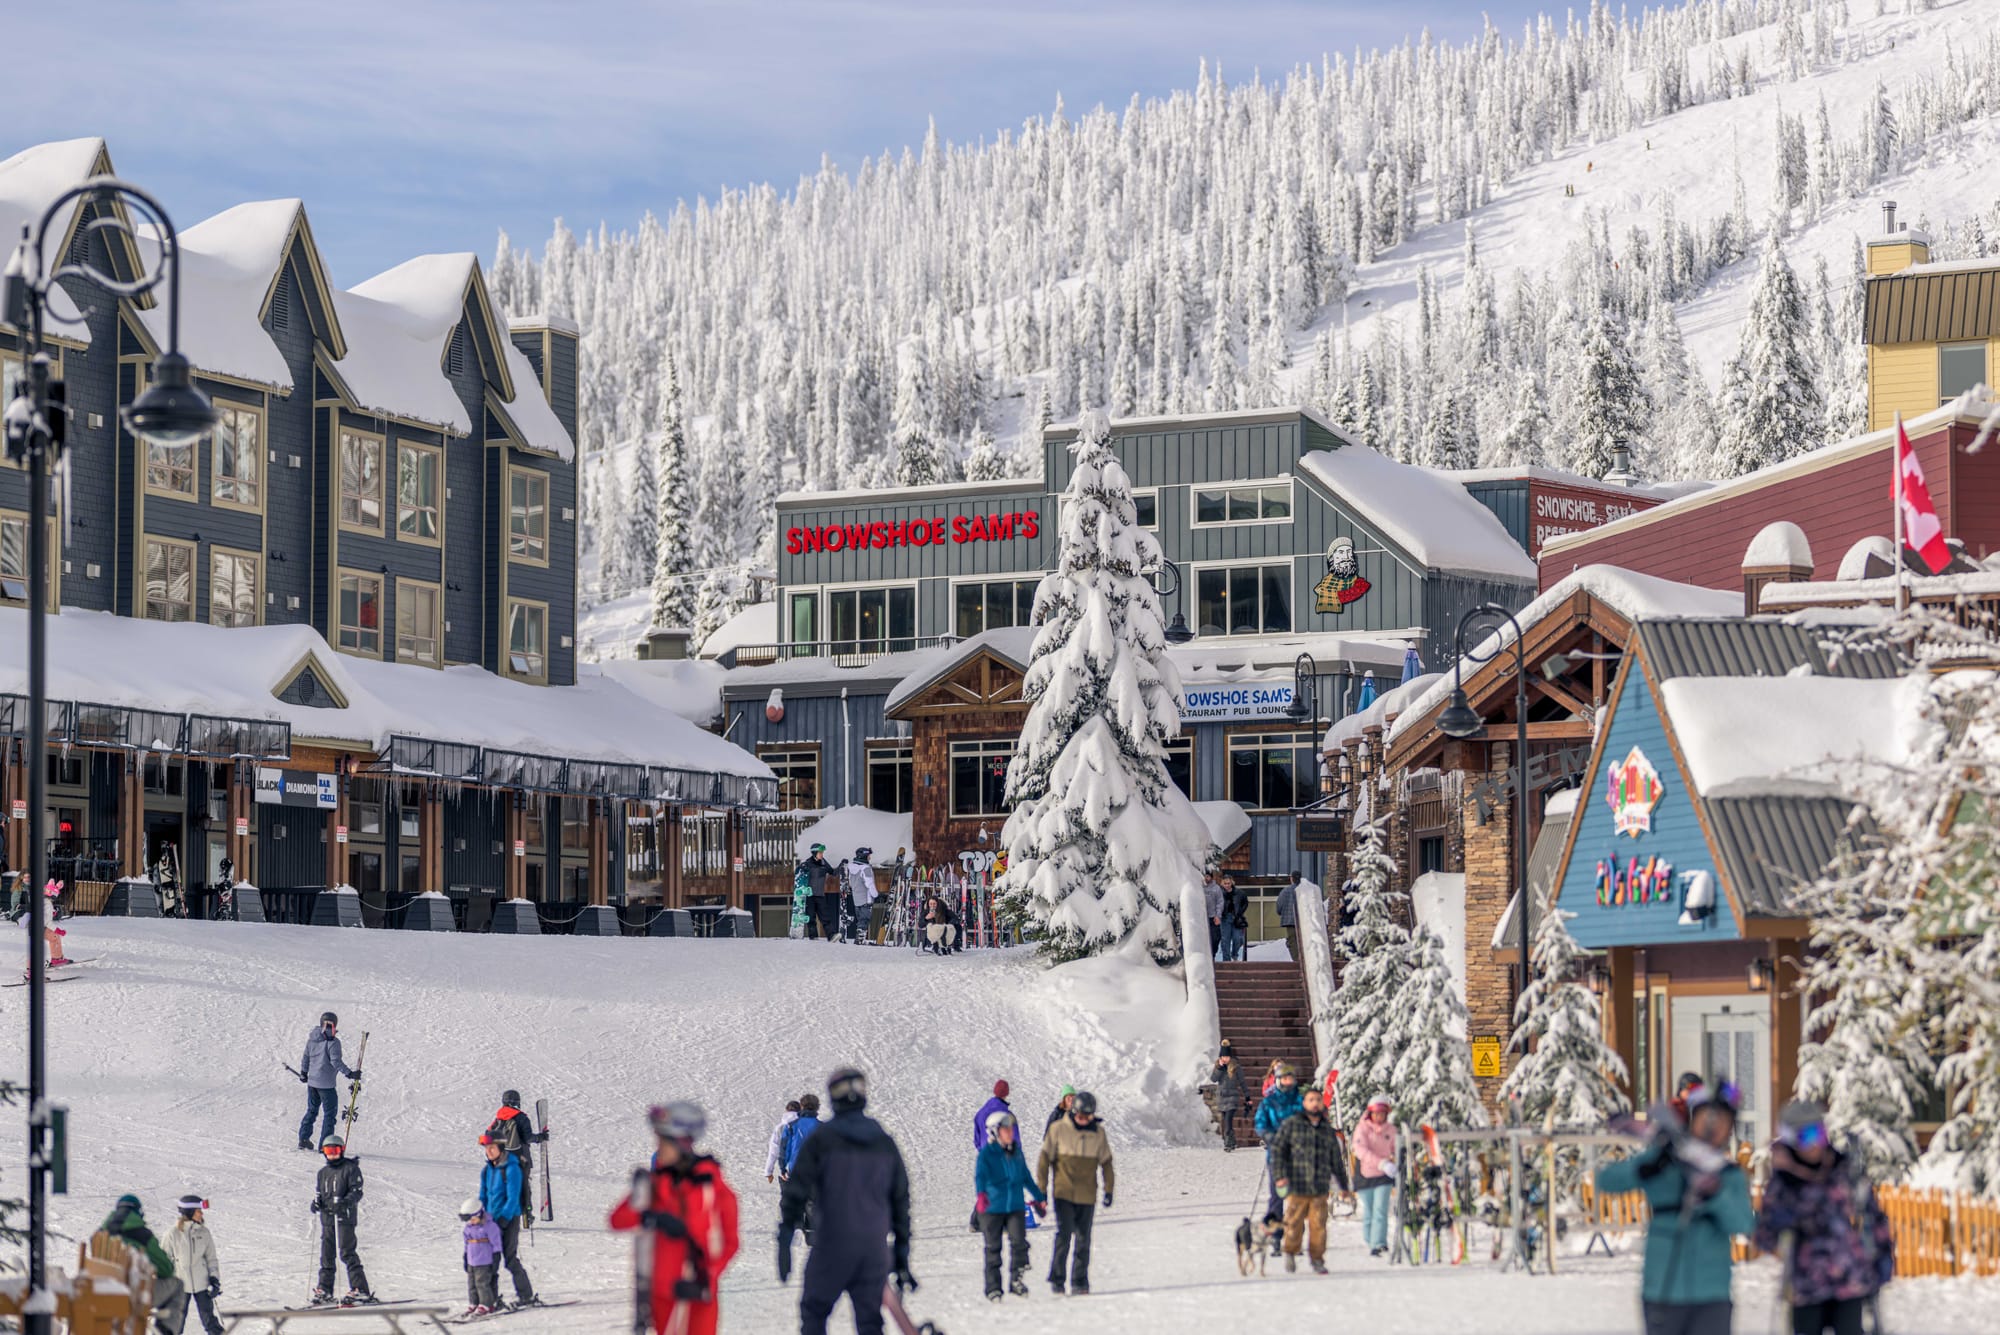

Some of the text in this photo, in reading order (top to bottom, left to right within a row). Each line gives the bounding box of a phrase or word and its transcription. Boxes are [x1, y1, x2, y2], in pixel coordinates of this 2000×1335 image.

[1536, 495, 1596, 523] SNOWSHOE
[786, 510, 1039, 555] SNOWSHOE SAM'S
[1185, 688, 1292, 706] OWSHOE SAM'S
[1178, 705, 1288, 718] ESTAURANT PUB LOUNG
[256, 779, 317, 794] BLACK DIAMOND
